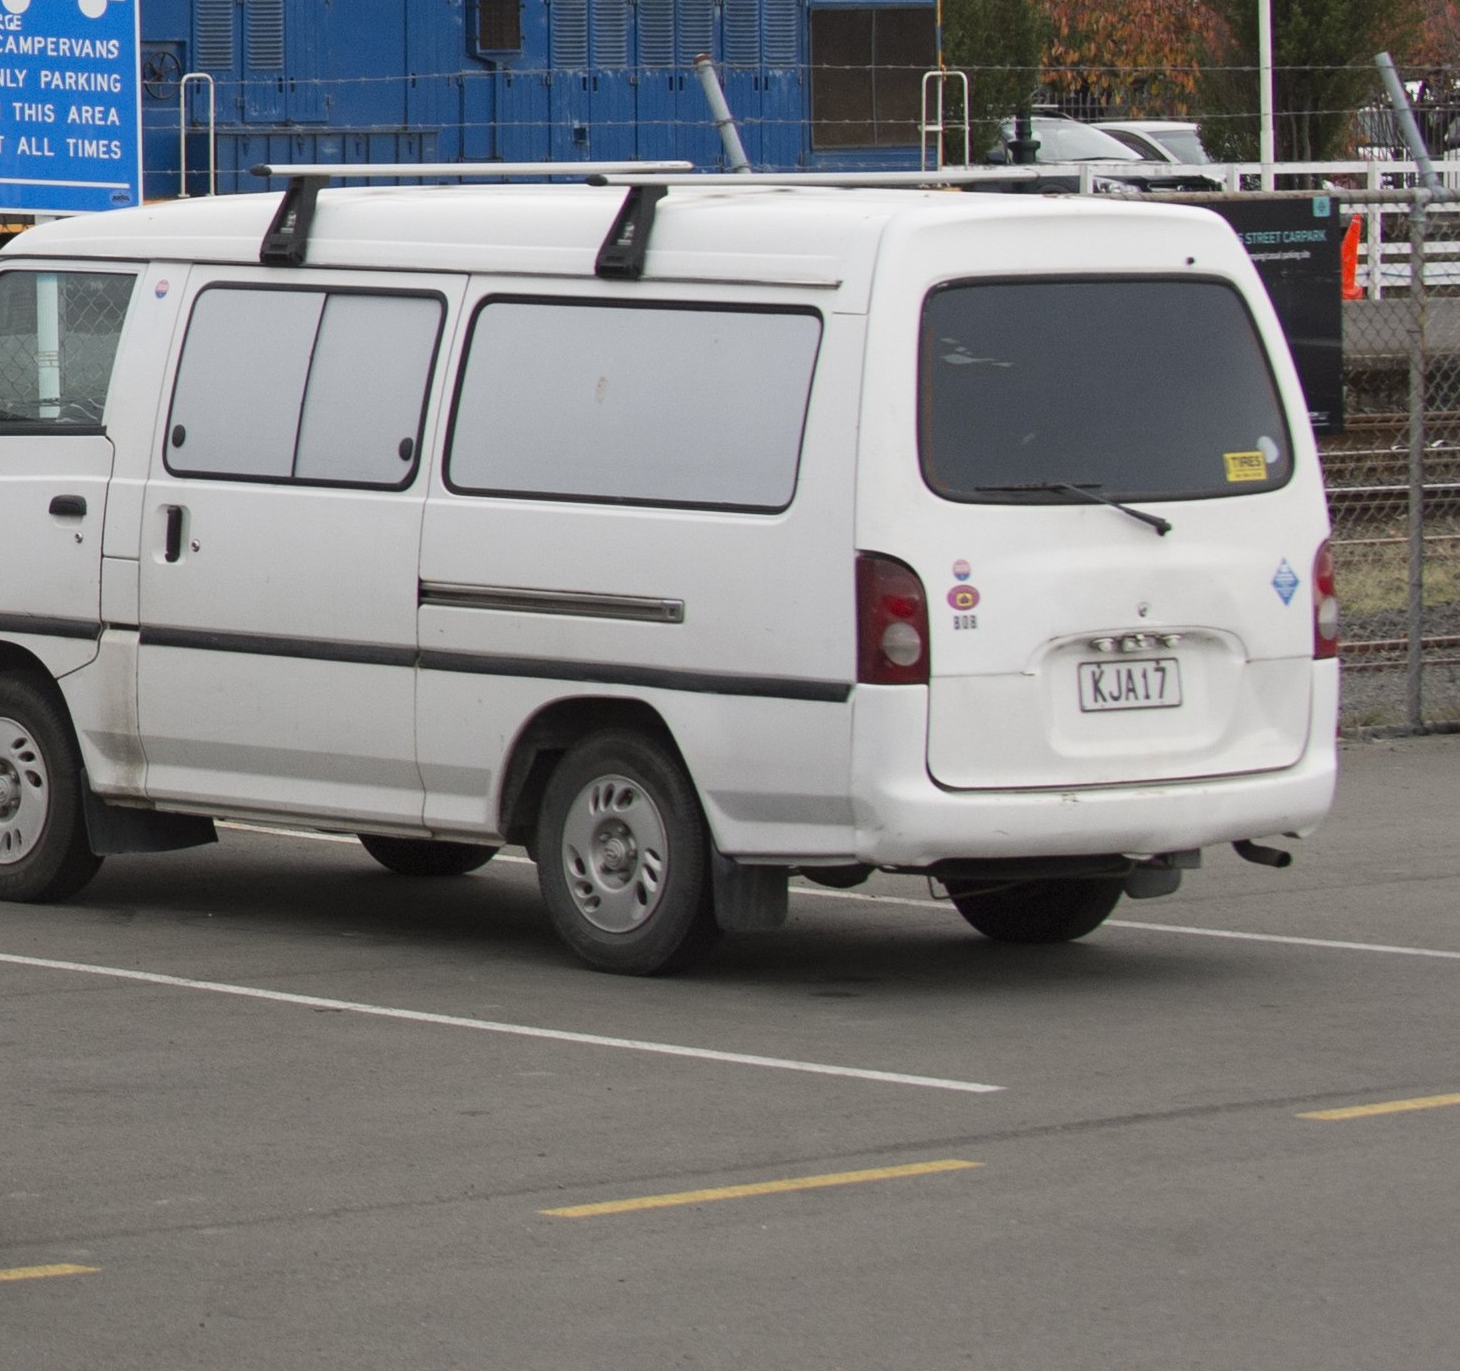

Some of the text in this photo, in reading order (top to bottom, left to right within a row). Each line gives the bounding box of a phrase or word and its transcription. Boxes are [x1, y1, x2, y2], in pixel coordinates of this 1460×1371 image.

[40, 70, 122, 93] PARKING
[12, 102, 56, 123] THIS
[67, 104, 121, 126] AREA
[17, 137, 55, 157] ALL
[67, 139, 122, 160] TIMES
[1245, 230, 1281, 244] STREET
[1282, 229, 1328, 243] CARPARK
[1091, 667, 1167, 703] KJA17
